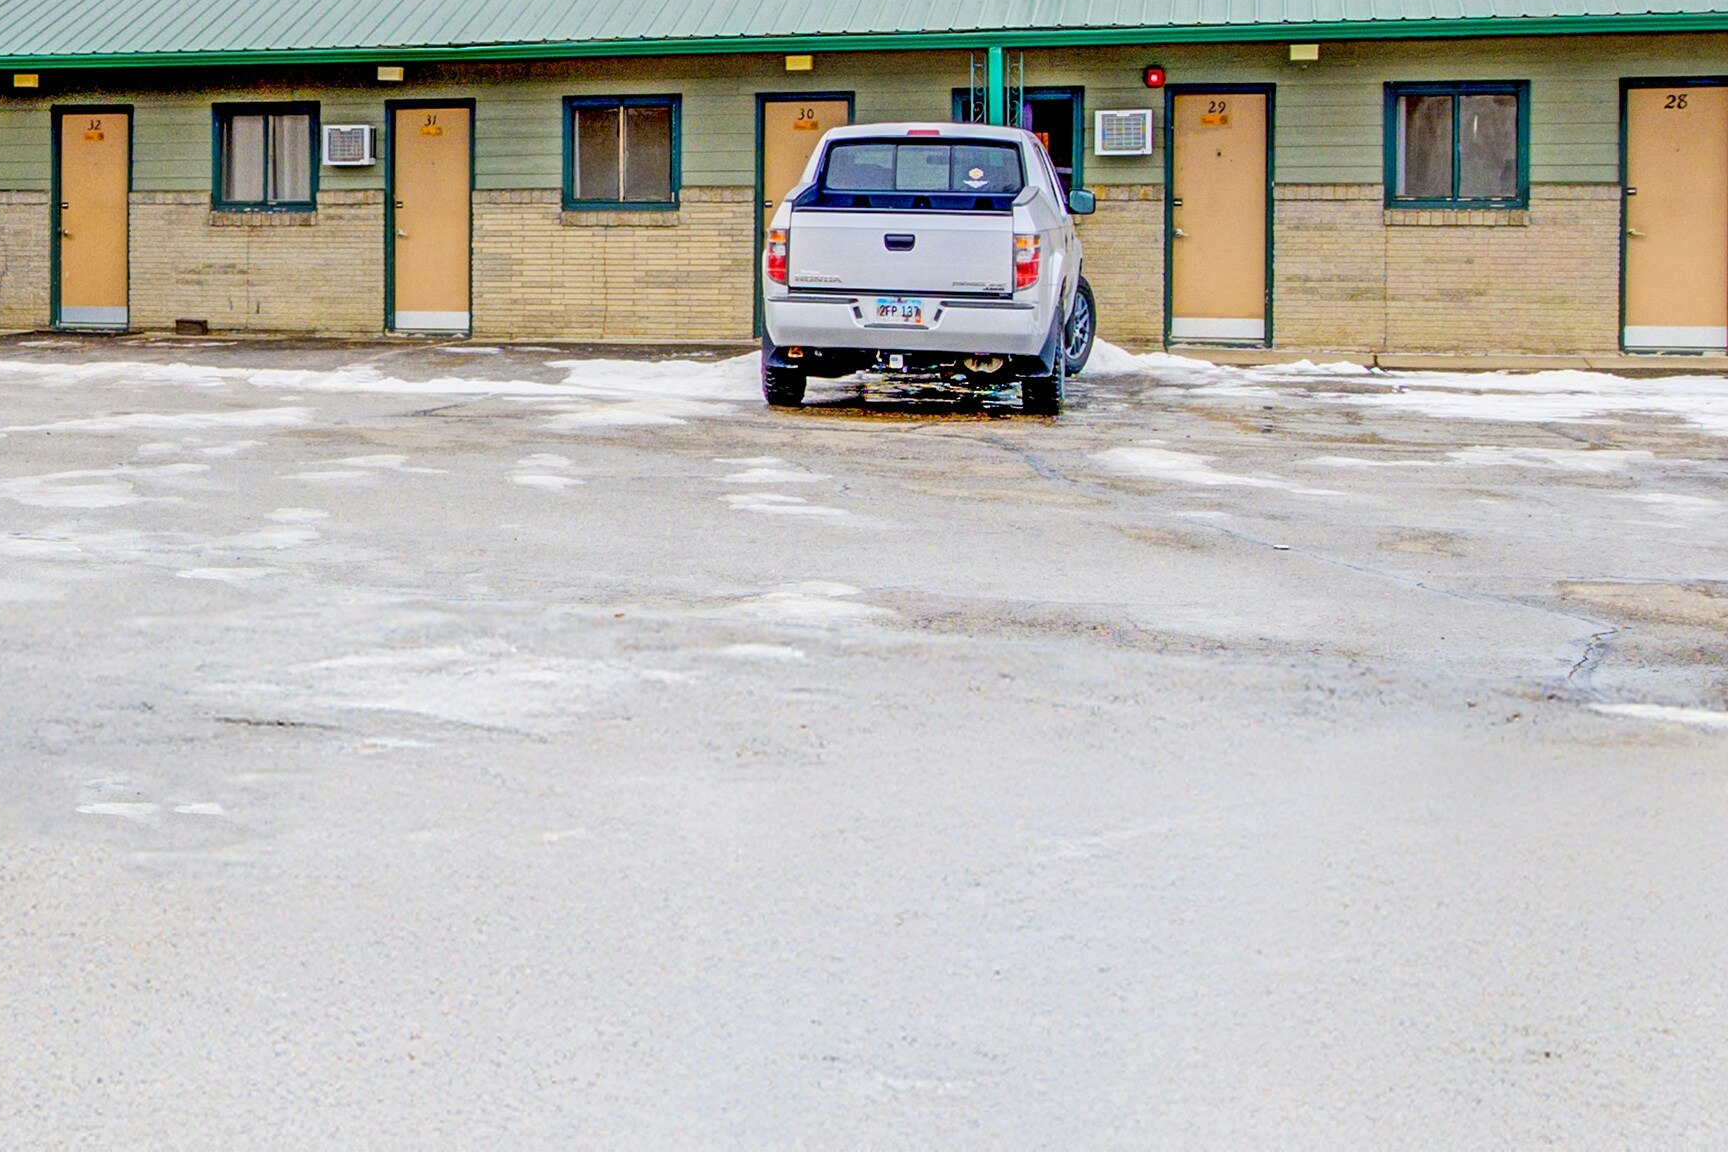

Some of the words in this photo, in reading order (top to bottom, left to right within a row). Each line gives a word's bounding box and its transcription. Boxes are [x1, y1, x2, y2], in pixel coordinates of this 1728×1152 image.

[1208, 100, 1227, 114] 29
[1663, 93, 1688, 110] 28
[424, 114, 437, 127] 31
[797, 107, 815, 121] 30
[87, 119, 101, 131] 32
[794, 276, 842, 284] HONDA
